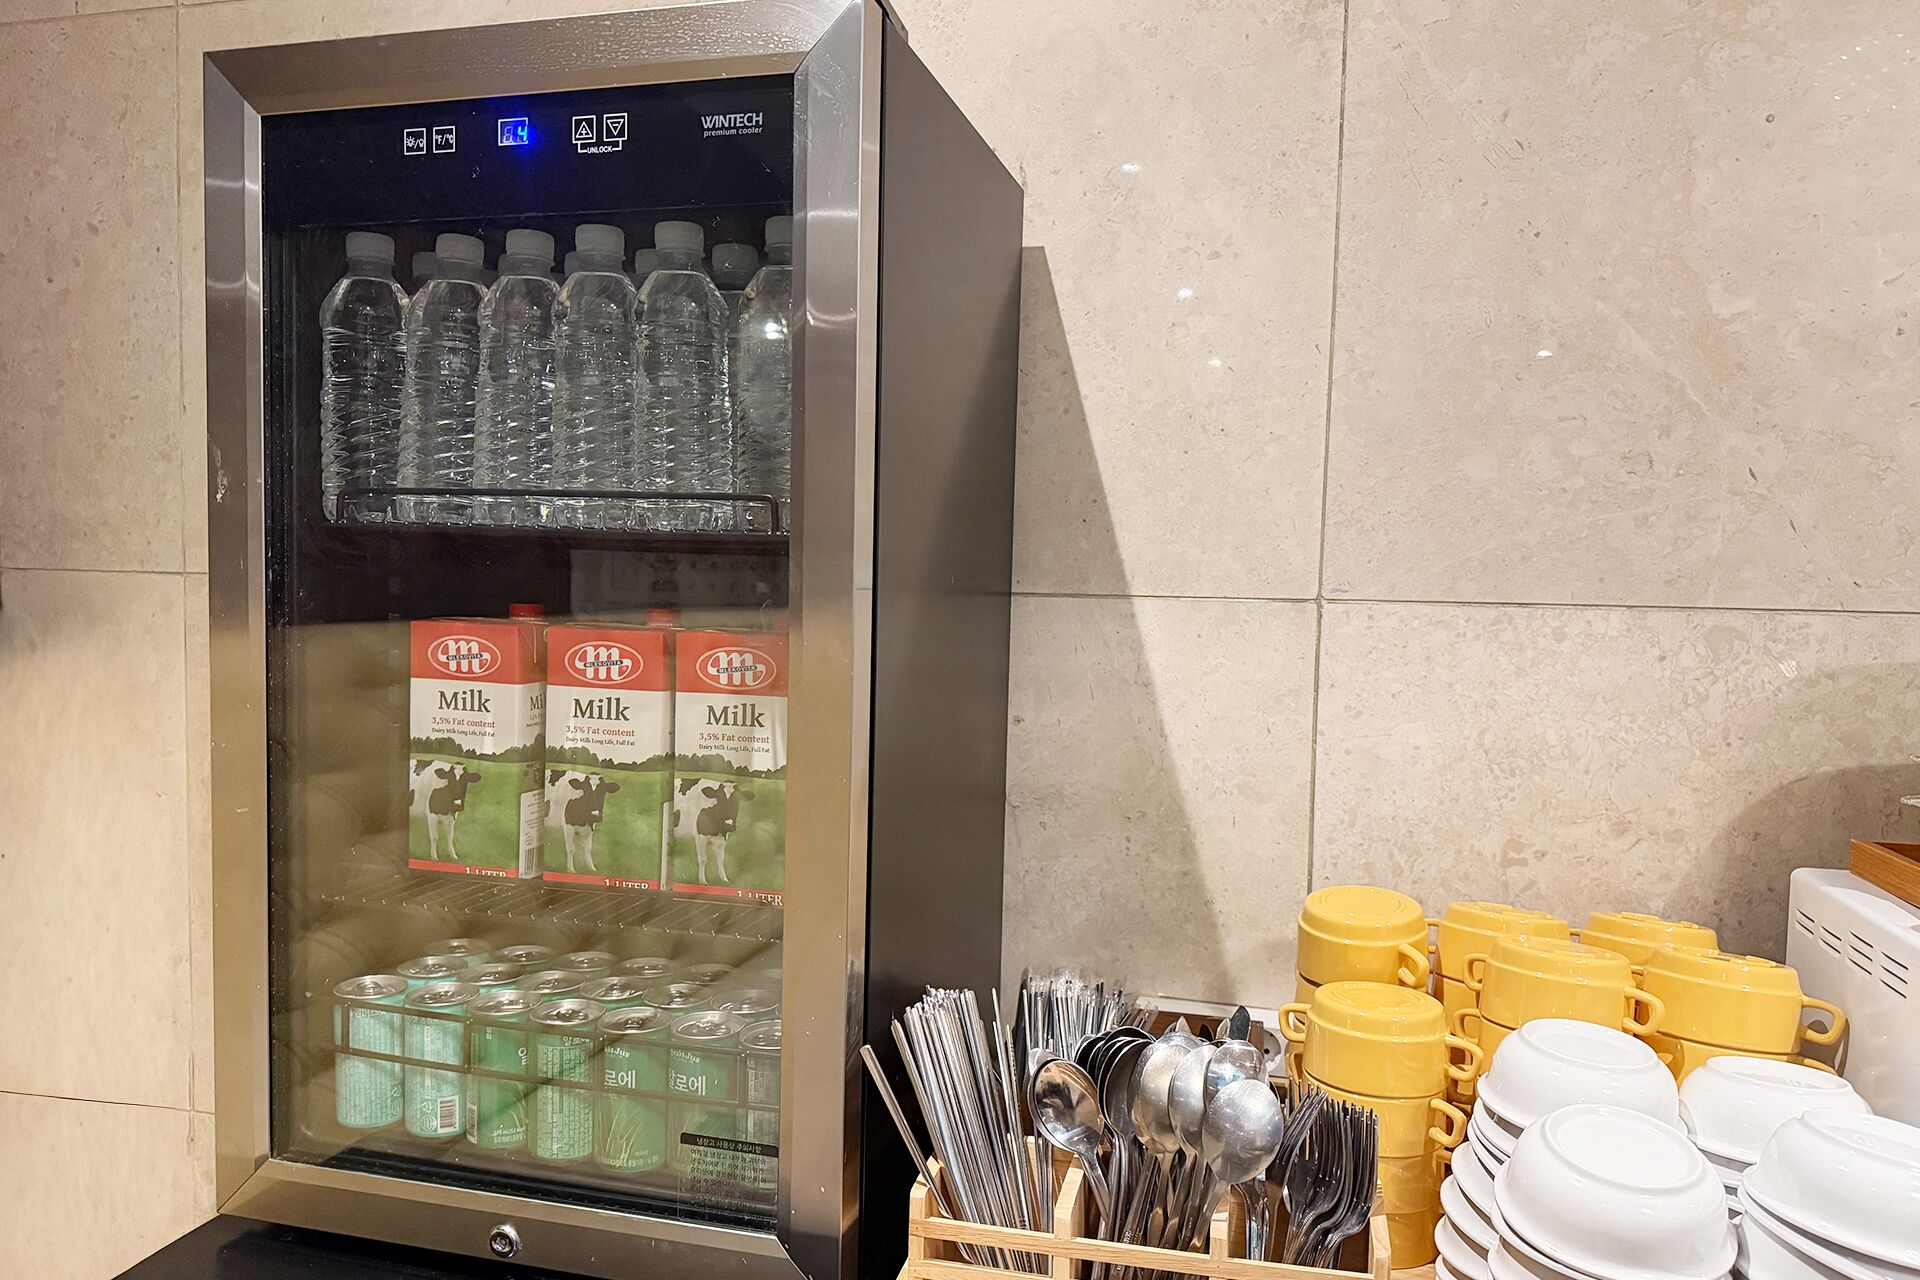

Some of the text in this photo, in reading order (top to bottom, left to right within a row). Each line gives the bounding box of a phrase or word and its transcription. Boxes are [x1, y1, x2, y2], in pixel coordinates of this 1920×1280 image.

[701, 112, 764, 129] WINTECH
[703, 127, 763, 138] premium cooler
[587, 145, 613, 154] UNLOCK
[438, 689, 491, 713] Milk
[573, 697, 630, 721] Milk
[706, 703, 765, 728] Milk
[432, 717, 495, 728] 3,5% Fat content
[566, 725, 635, 737] 3,5% Fat content
[566, 736, 579, 744] Dairy
[592, 738, 604, 746] Long
[699, 732, 770, 744] 3,5% Fat content
[699, 743, 712, 752] Dairy
[604, 878, 610, 887] 1
[736, 889, 742, 898] 1
[696, 1137, 762, 1154] 냉장고 사용상 주의사항
